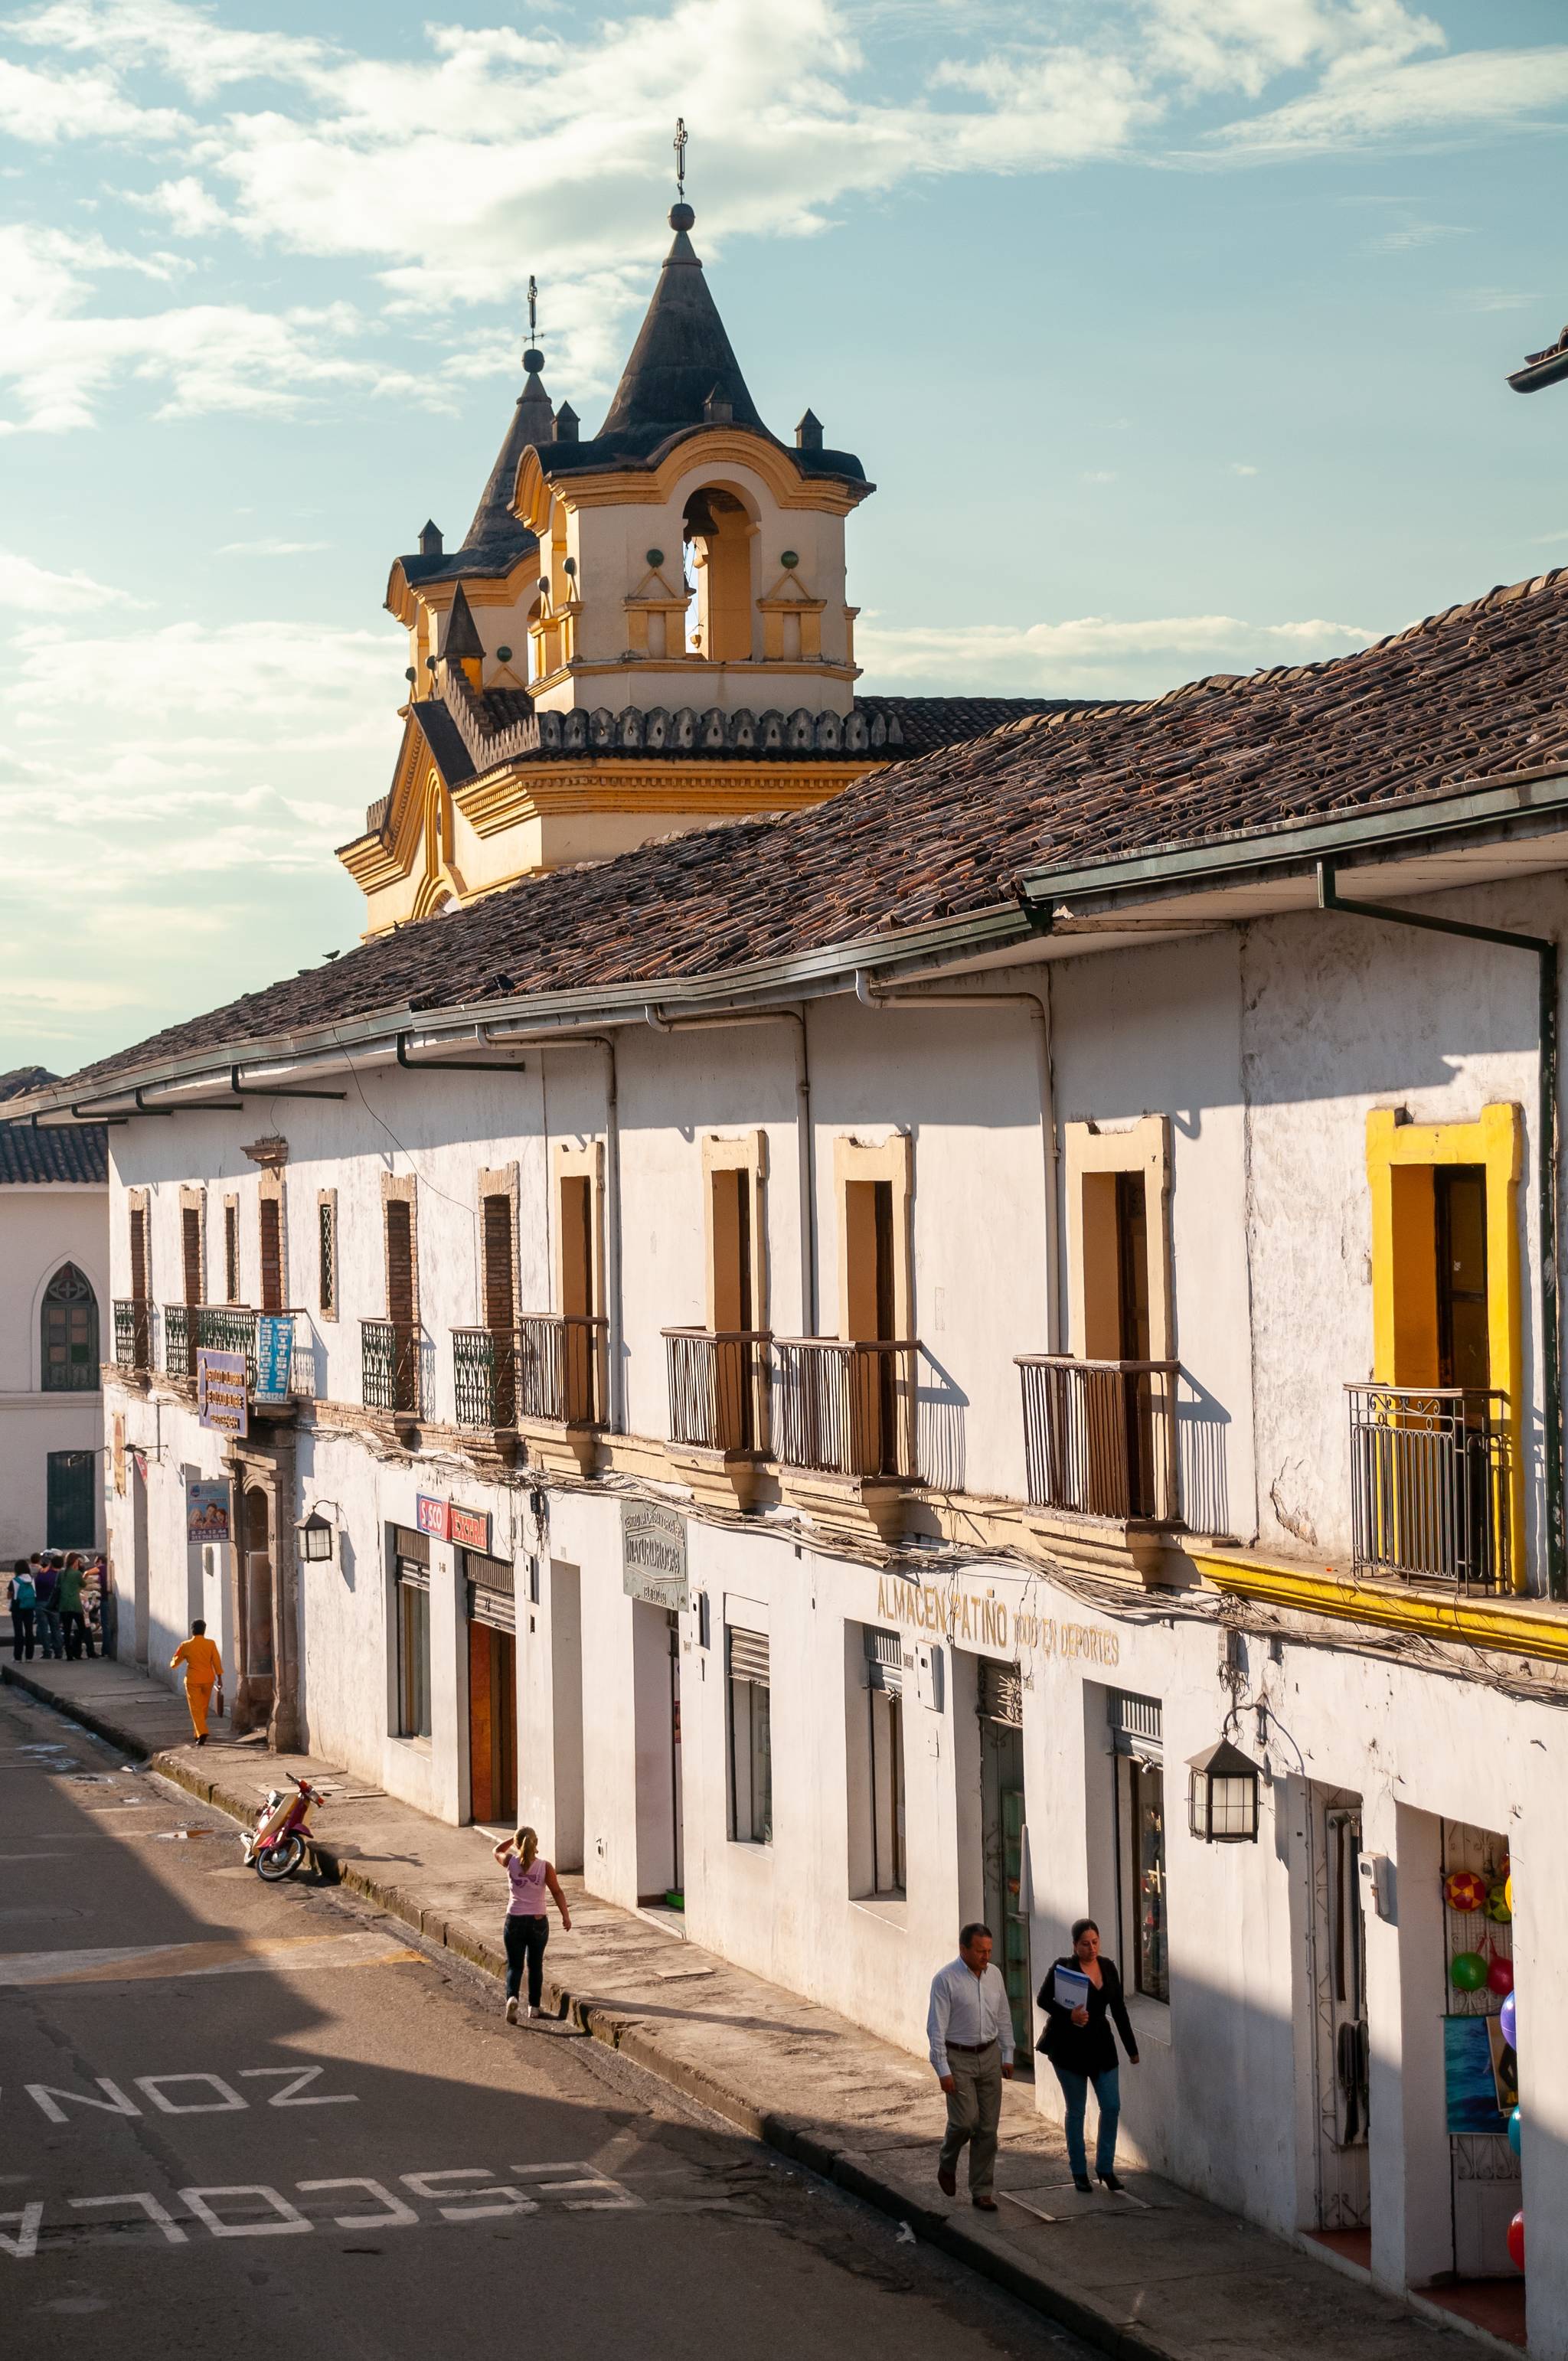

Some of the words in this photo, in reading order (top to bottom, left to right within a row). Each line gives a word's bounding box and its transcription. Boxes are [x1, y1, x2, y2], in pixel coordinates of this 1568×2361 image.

[451, 1507, 487, 1550] EXTRA
[628, 1537, 680, 1574] NATURDROGAS
[877, 1576, 946, 1634] ALMACEN
[1060, 1623, 1119, 1667] DEPORTES
[0, 2065, 360, 2123] ZON
